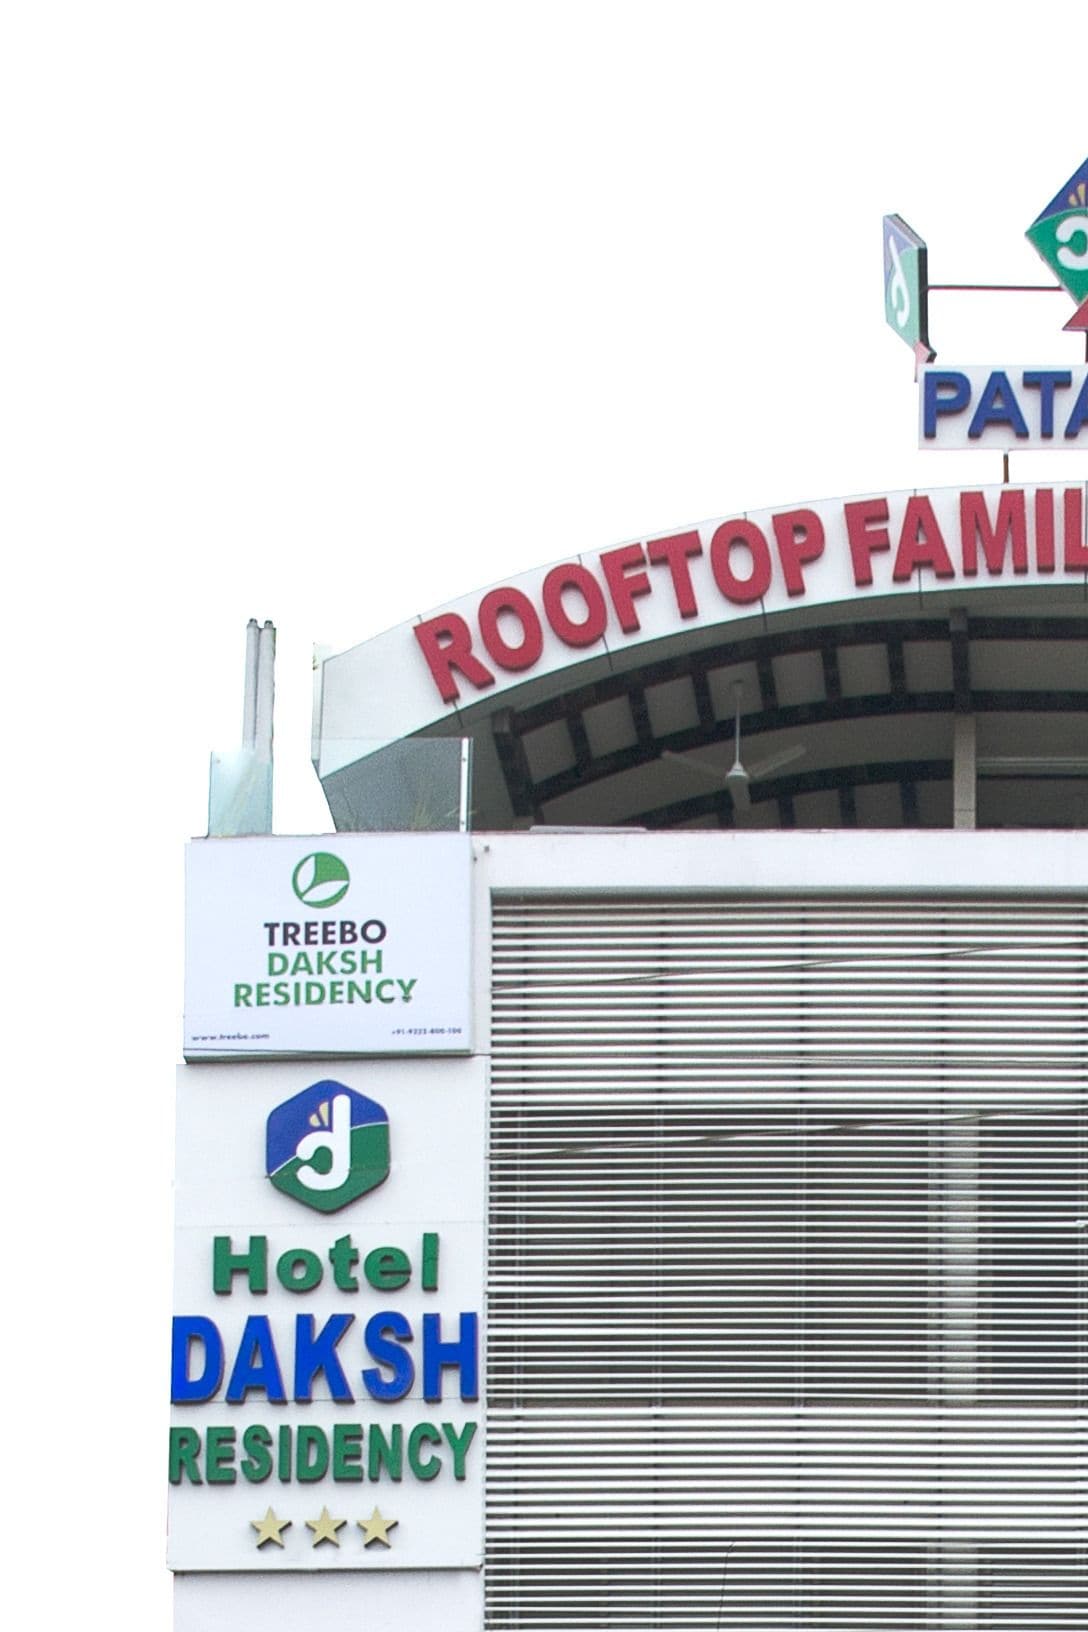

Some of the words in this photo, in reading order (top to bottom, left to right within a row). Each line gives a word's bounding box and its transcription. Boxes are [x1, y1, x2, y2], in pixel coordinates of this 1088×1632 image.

[413, 508, 826, 702] ROOFTOP
[263, 919, 387, 947] TREEBO
[267, 949, 383, 977] DAKSH
[233, 978, 418, 1008] RESIDENCY
[212, 1232, 439, 1295] Hotel
[170, 1311, 479, 1405] DAKSH
[168, 1421, 478, 1486] RESIDENCY
